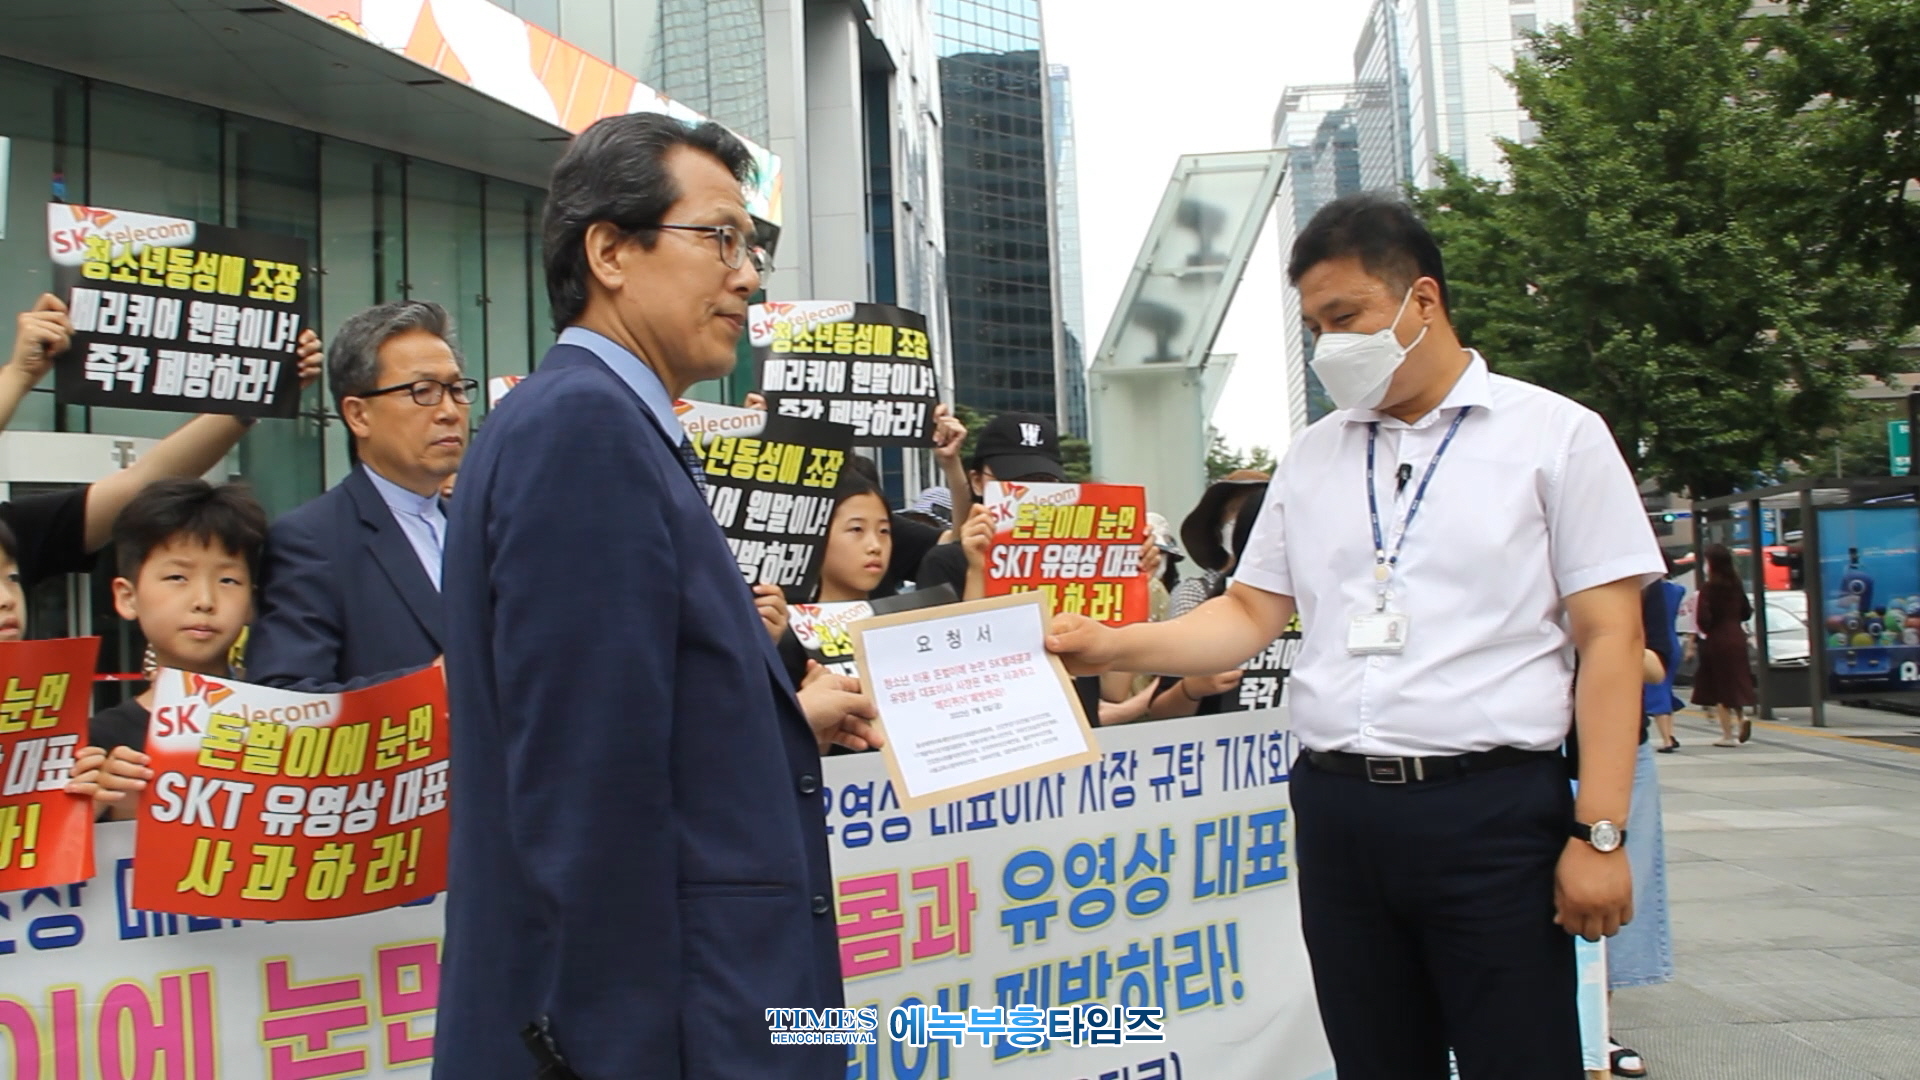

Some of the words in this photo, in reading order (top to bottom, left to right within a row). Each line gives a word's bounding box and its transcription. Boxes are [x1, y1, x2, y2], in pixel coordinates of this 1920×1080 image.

[105, 222, 191, 244] telecom
[248, 257, 301, 303] 조장
[790, 302, 851, 326] telecom
[896, 327, 928, 360] 조장
[84, 342, 150, 393] 즉각
[152, 348, 281, 404] 폐방하라!
[802, 448, 845, 489] 조장
[1012, 503, 1096, 539] 돈벌이에
[1096, 505, 1136, 540] 눈먼
[989, 544, 1040, 579] SKT
[1040, 544, 1103, 579] 유영상
[1101, 544, 1142, 578] 대표
[156, 703, 201, 737] SK
[197, 712, 369, 778] 돈벌이에
[375, 704, 433, 771] 눈먼
[3, 734, 79, 796] 대표
[1079, 750, 1138, 814] 사장
[1149, 741, 1205, 803] 규탄
[151, 771, 255, 830] SKT
[259, 778, 386, 837] 유영상
[388, 759, 450, 825] 대표
[999, 825, 1177, 947] 유영상
[1192, 807, 1291, 899] 대표
